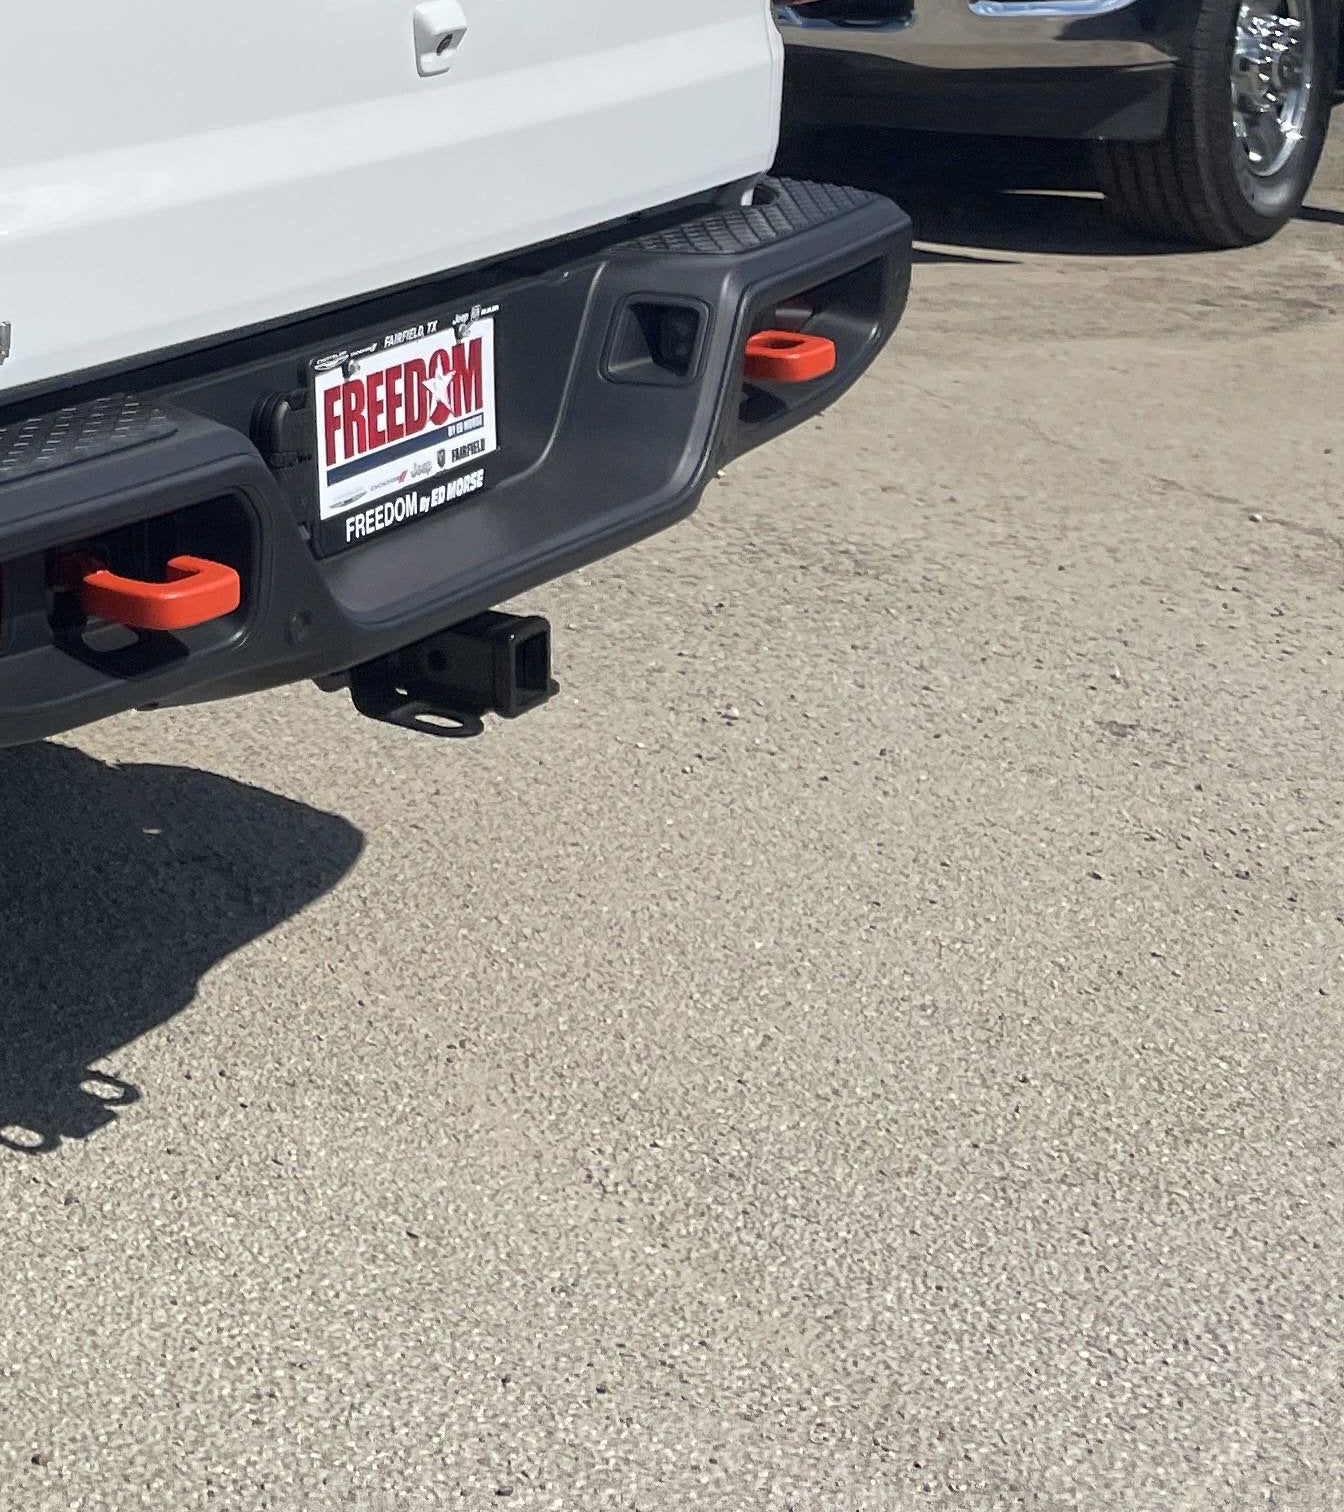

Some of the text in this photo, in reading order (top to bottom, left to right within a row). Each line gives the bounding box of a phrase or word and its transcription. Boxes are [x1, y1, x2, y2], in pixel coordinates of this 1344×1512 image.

[426, 319, 439, 335] TX
[324, 337, 484, 467] FREEDOM
[451, 437, 486, 464] FAIRFIELD
[345, 490, 418, 543] FREEDOM
[430, 484, 447, 508] ED
[446, 468, 484, 502] MORSE
